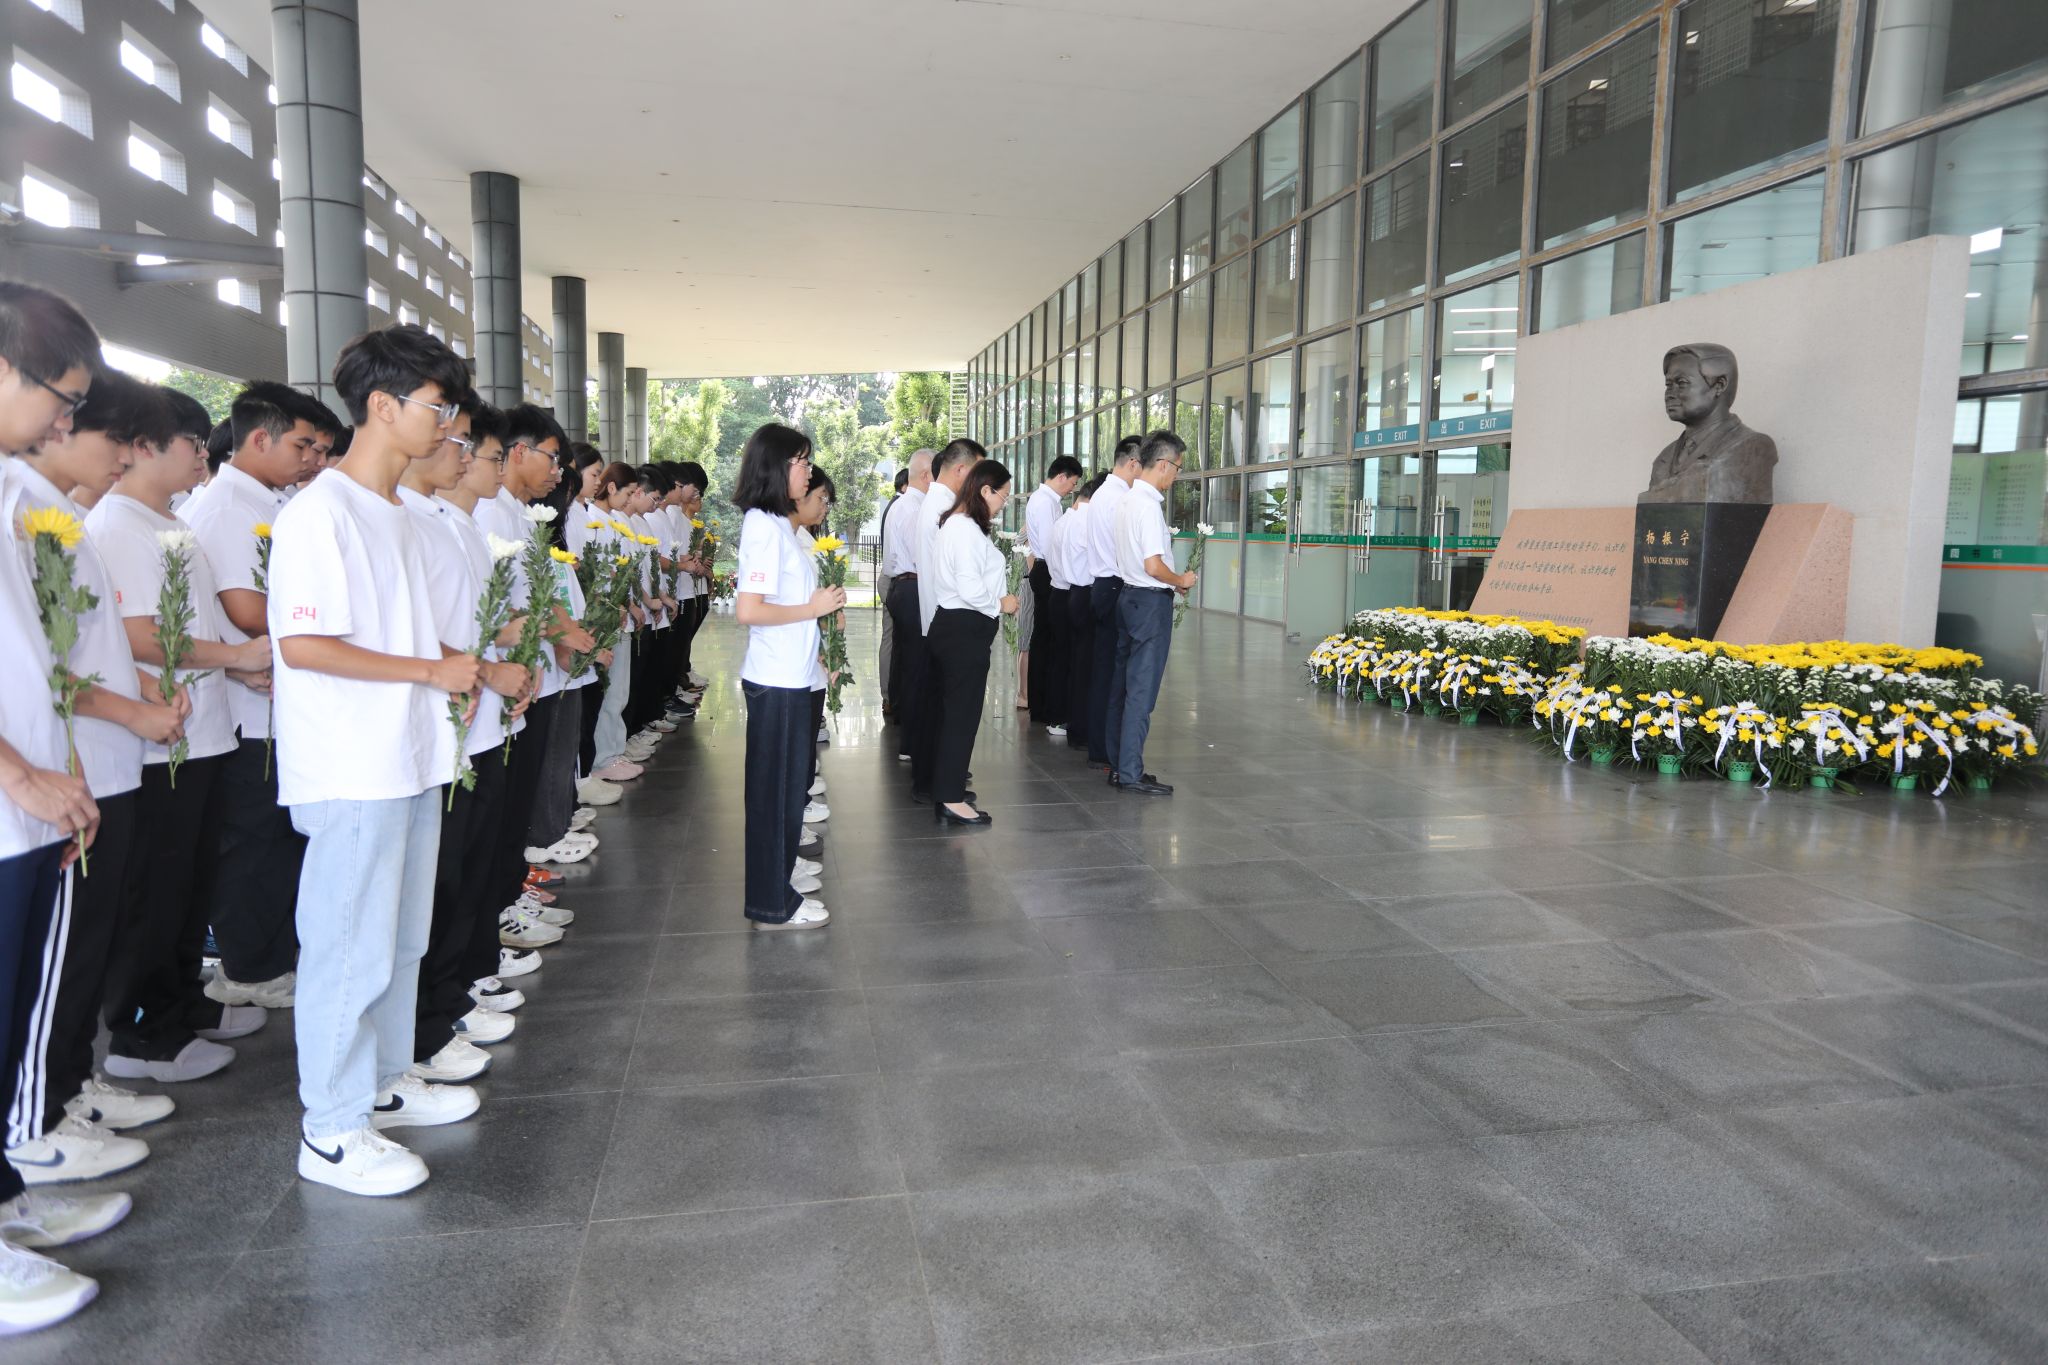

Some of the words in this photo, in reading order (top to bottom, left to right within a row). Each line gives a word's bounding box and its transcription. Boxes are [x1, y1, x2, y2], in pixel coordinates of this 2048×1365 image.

[1441, 421, 1464, 435] 出口
[1480, 417, 1497, 430] EXIT
[1364, 432, 1383, 445] 出口
[1394, 430, 1408, 441] EXIT
[1646, 529, 1689, 546] 杨振宁
[1643, 555, 1657, 564] YANG
[1658, 556, 1674, 565] CHEN
[1674, 557, 1689, 566] NING
[750, 571, 765, 582] 23
[293, 606, 316, 620] 24
